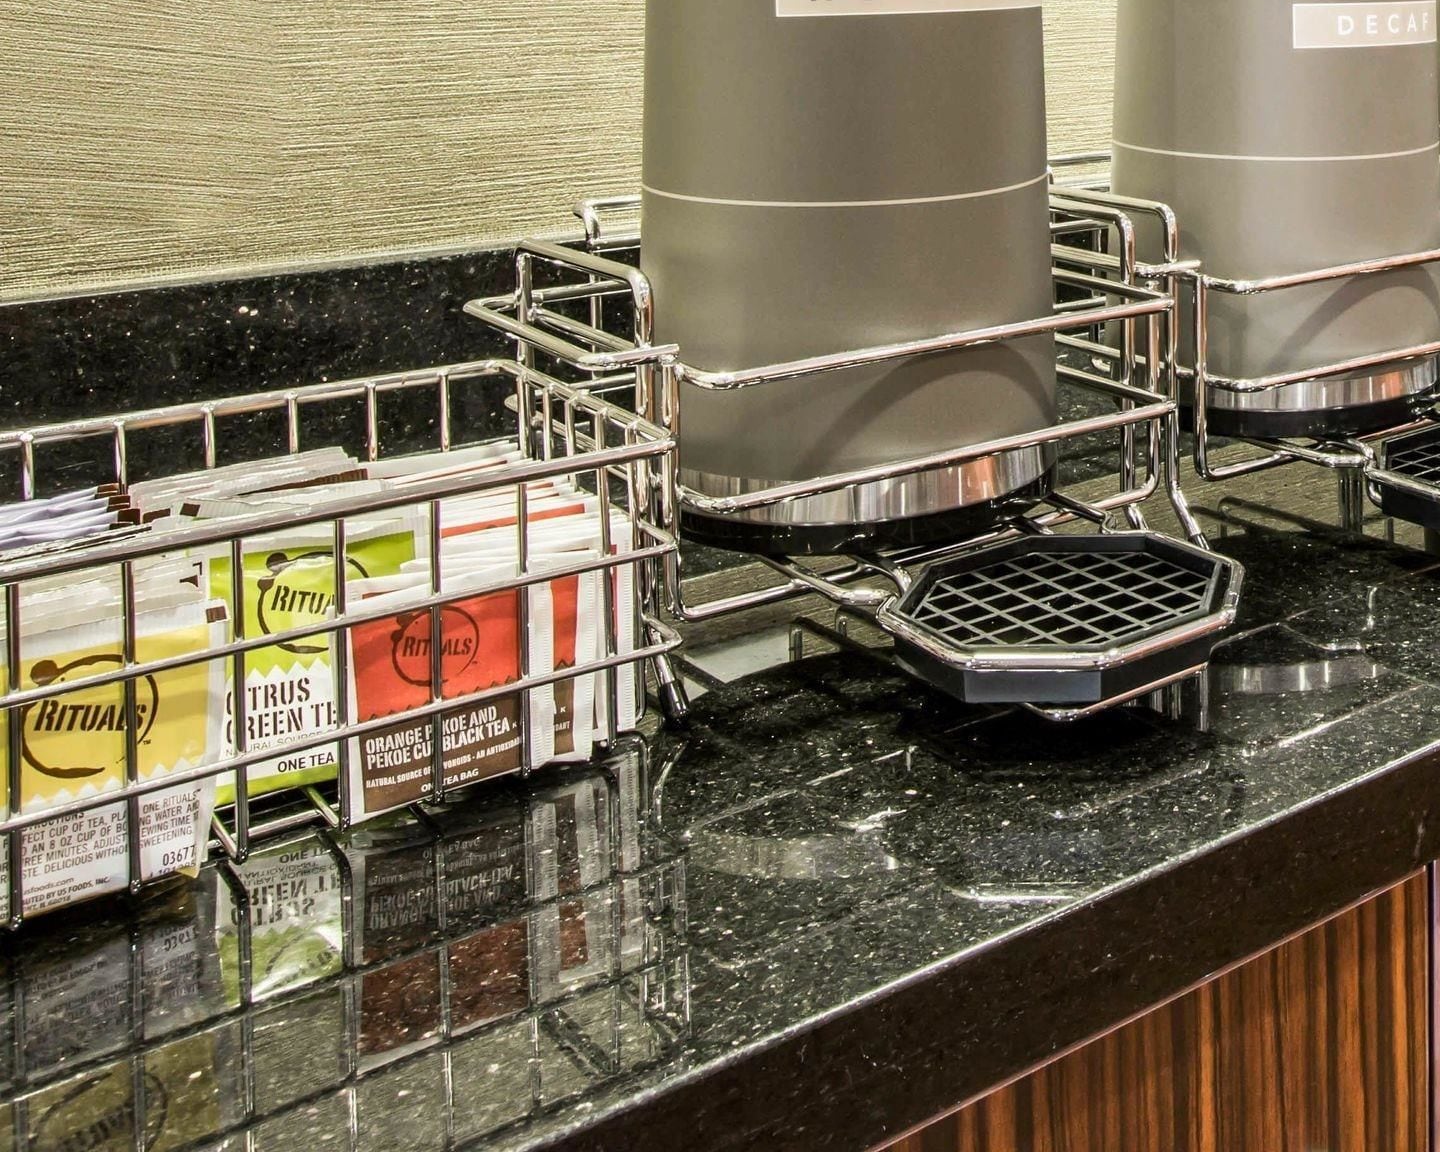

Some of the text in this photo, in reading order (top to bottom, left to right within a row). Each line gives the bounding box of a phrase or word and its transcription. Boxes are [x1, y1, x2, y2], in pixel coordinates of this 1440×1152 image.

[1337, 12, 1429, 36] DECAF
[271, 584, 334, 615] RITUA
[402, 636, 472, 657] RITALS
[226, 677, 310, 716] CTRUS
[34, 700, 147, 732] RITUALS
[311, 701, 337, 727] TE
[365, 705, 497, 755] ORANGE PKOE AND
[366, 746, 411, 770] PEKOE
[413, 741, 432, 759] CU
[442, 725, 485, 752] BLACK
[486, 716, 510, 738] TEA
[278, 751, 334, 773] ONE TEA
[366, 776, 396, 789] NATURAL
[396, 769, 422, 784] SOURCE
[423, 765, 432, 776] OF
[443, 753, 472, 770] VONOIDS
[486, 736, 520, 757] ANTIOXIDAN
[421, 782, 434, 793] ON
[459, 768, 479, 781] BAG
[32, 841, 45, 854] AN
[60, 835, 72, 848] OZ
[77, 829, 96, 843] CUP
[100, 824, 112, 837] OF
[155, 805, 182, 822] WATER
[49, 825, 69, 838] CUP
[72, 821, 85, 833] OF
[111, 810, 127, 823] PLA
[143, 801, 160, 814] ONE
[23, 856, 44, 868] REE
[141, 820, 169, 838] EWING
[170, 814, 191, 828] TIME
[162, 844, 196, 866] 03677
[44, 852, 93, 874] DELICIOUS
[96, 844, 128, 861] WITHO
[56, 887, 67, 897] US
